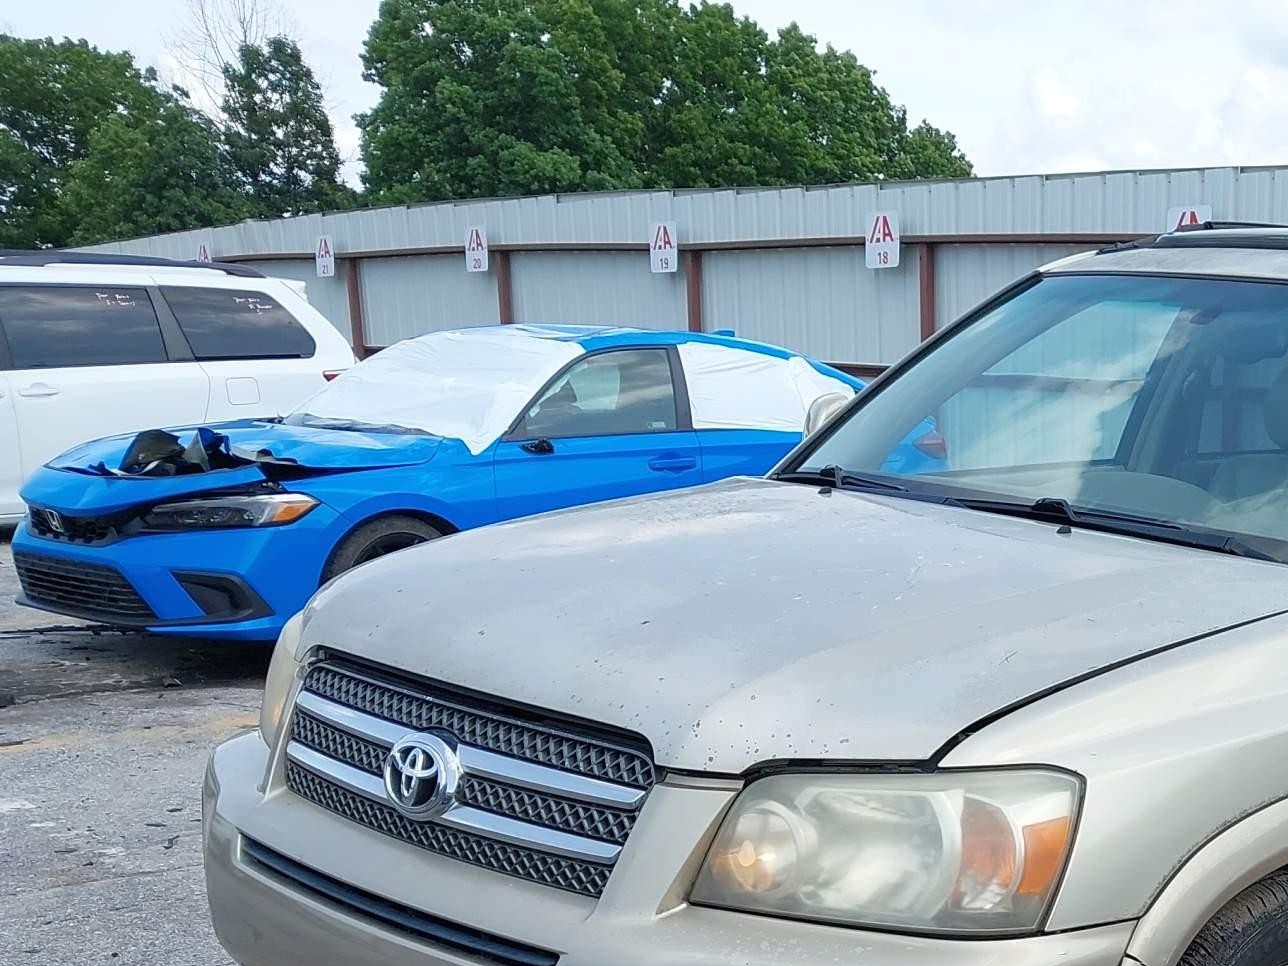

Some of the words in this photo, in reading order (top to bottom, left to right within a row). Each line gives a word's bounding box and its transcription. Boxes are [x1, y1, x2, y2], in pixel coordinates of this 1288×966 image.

[473, 257, 482, 269] 20
[659, 257, 669, 270] 19
[877, 251, 889, 265] 18
